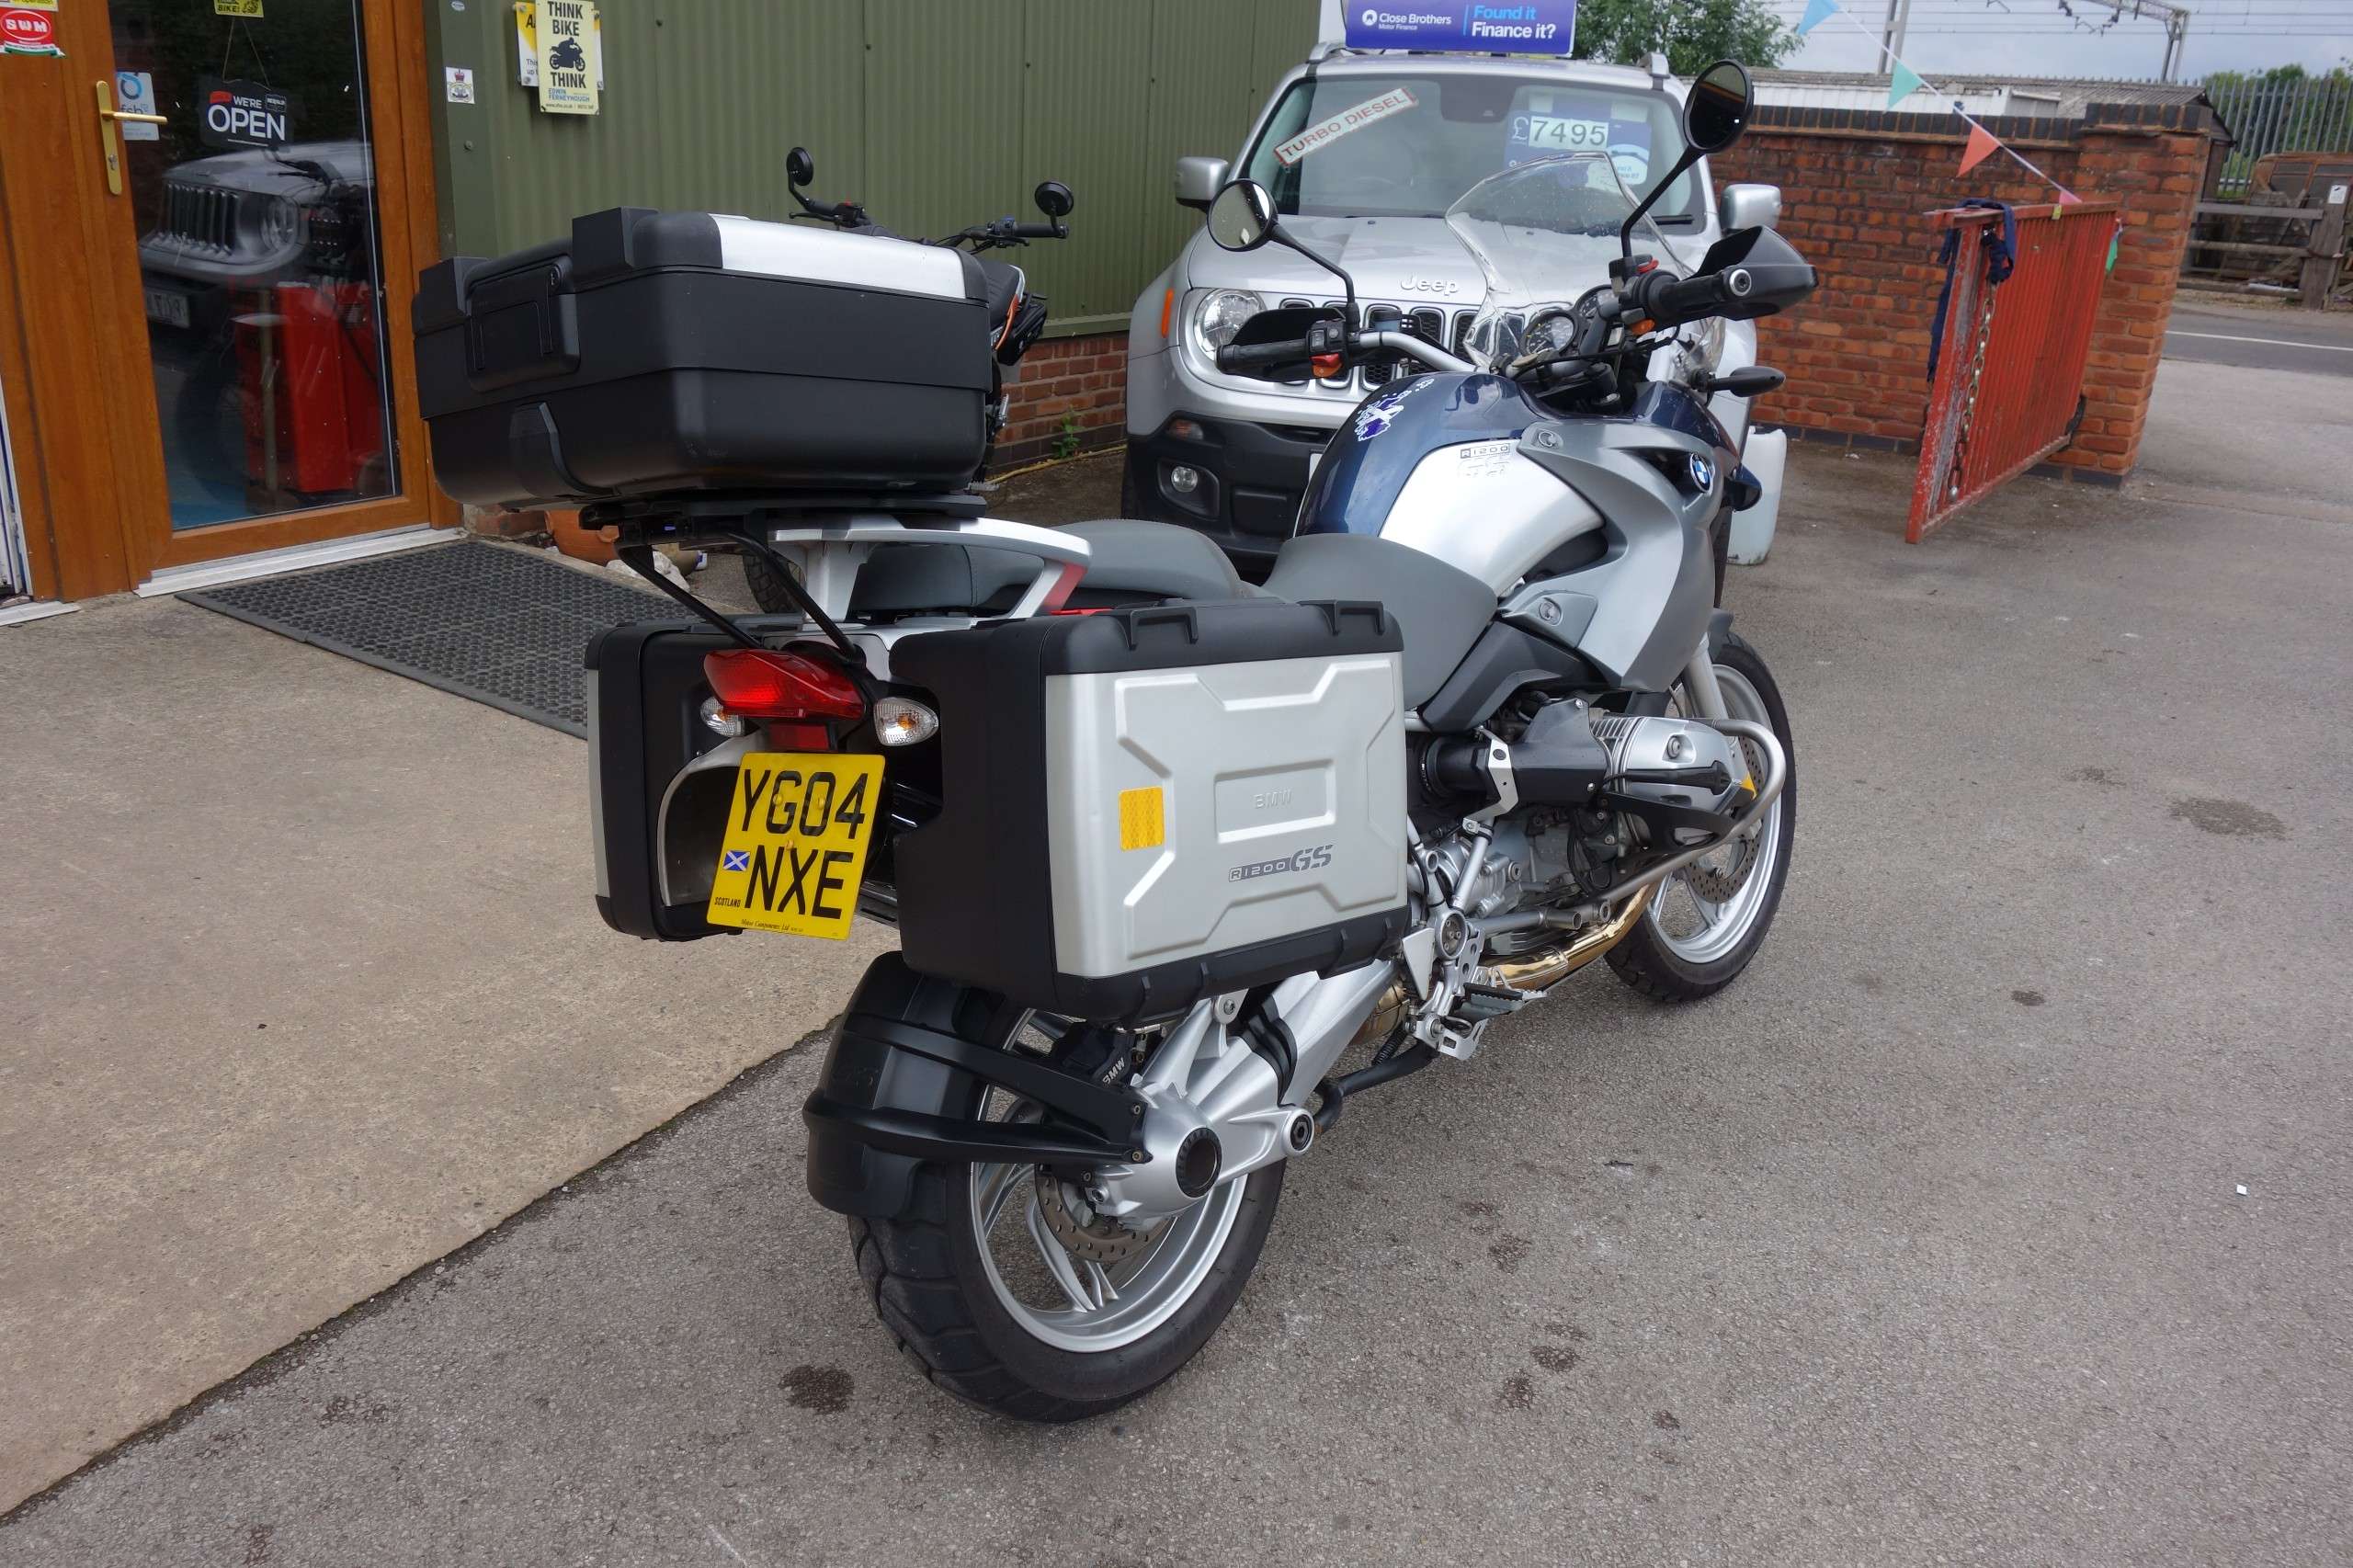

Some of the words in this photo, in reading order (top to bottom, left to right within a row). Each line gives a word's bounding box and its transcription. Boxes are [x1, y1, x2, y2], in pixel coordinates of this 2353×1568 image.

[547, 1, 584, 19] THINK
[1379, 13, 1407, 24] Close
[1409, 14, 1452, 26] Brothers
[1473, 5, 1521, 19] Found
[1526, 6, 1536, 20] it
[552, 19, 580, 37] BIKE
[1472, 22, 1533, 39] Finance
[1534, 23, 1557, 40] it?
[550, 72, 586, 88] THINK
[208, 104, 286, 142] OPEN
[1280, 121, 1342, 157] TURBO
[1345, 94, 1408, 126] DIESEL
[1399, 272, 1460, 297] Jeep
[742, 768, 869, 840] YG04
[1253, 789, 1292, 809] BMW
[745, 845, 854, 920] NXE
[714, 896, 742, 908] SCOTLAND
[1103, 1057, 1125, 1085] BMW
